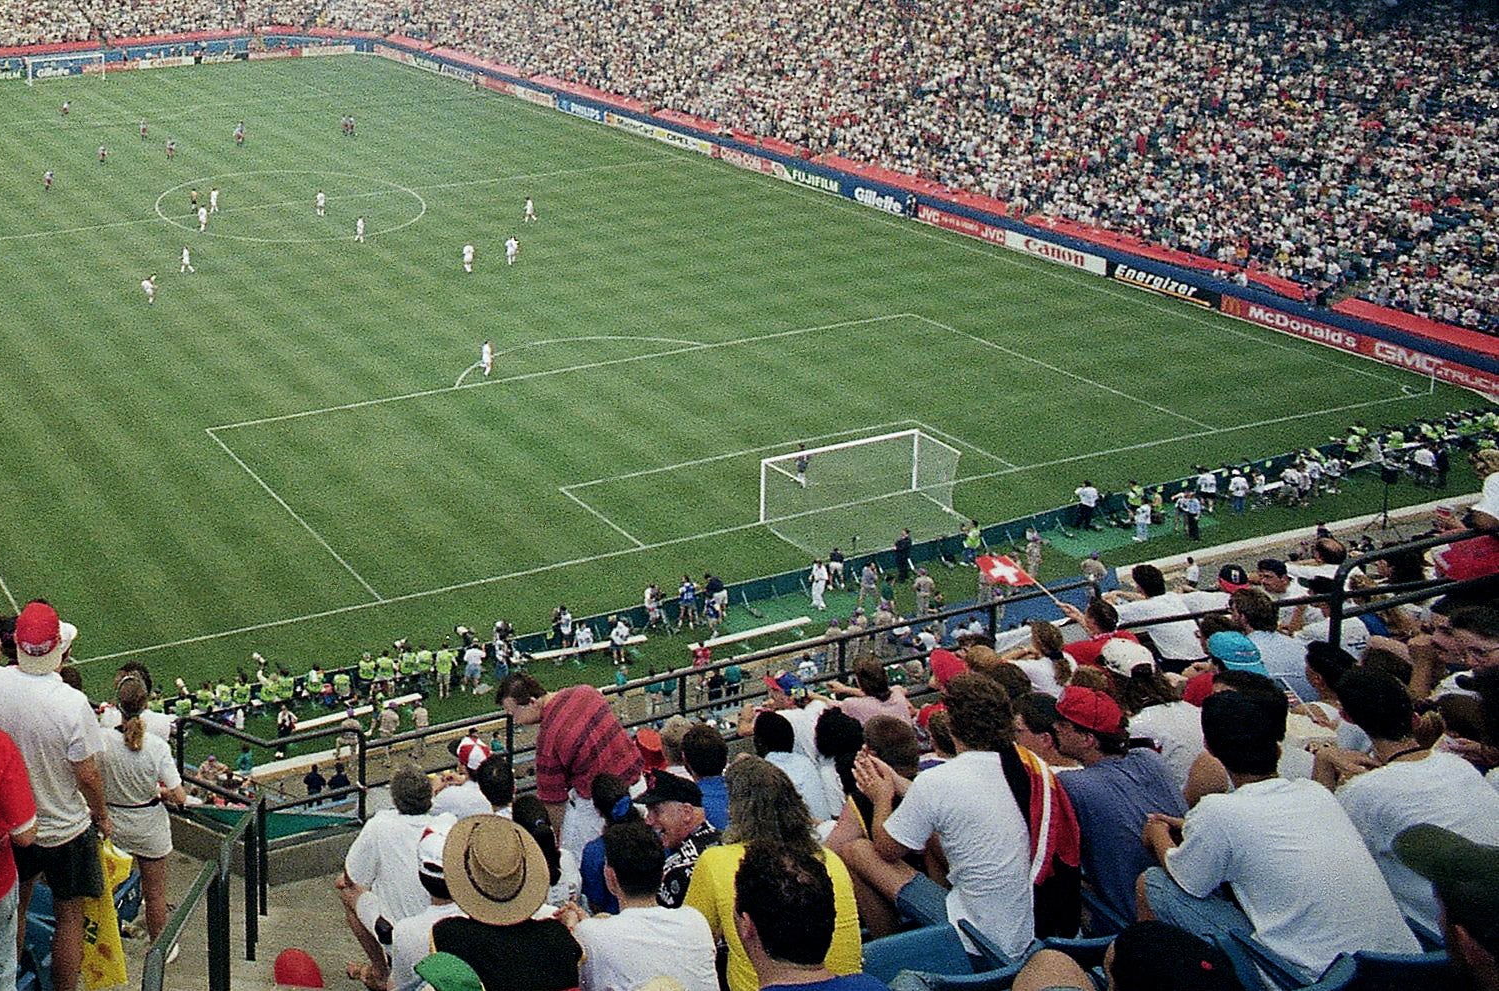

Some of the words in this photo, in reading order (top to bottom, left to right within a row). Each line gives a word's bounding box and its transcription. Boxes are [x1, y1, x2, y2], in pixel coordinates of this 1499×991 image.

[791, 169, 840, 193] FUJIFILM
[854, 187, 902, 213] Gillette
[918, 207, 940, 223] JVC
[981, 226, 1005, 243] JVC
[1023, 238, 1085, 267] Canon
[1114, 263, 1199, 297] Energizer
[1247, 305, 1358, 349] McDonald's
[1373, 340, 1444, 372] GMC
